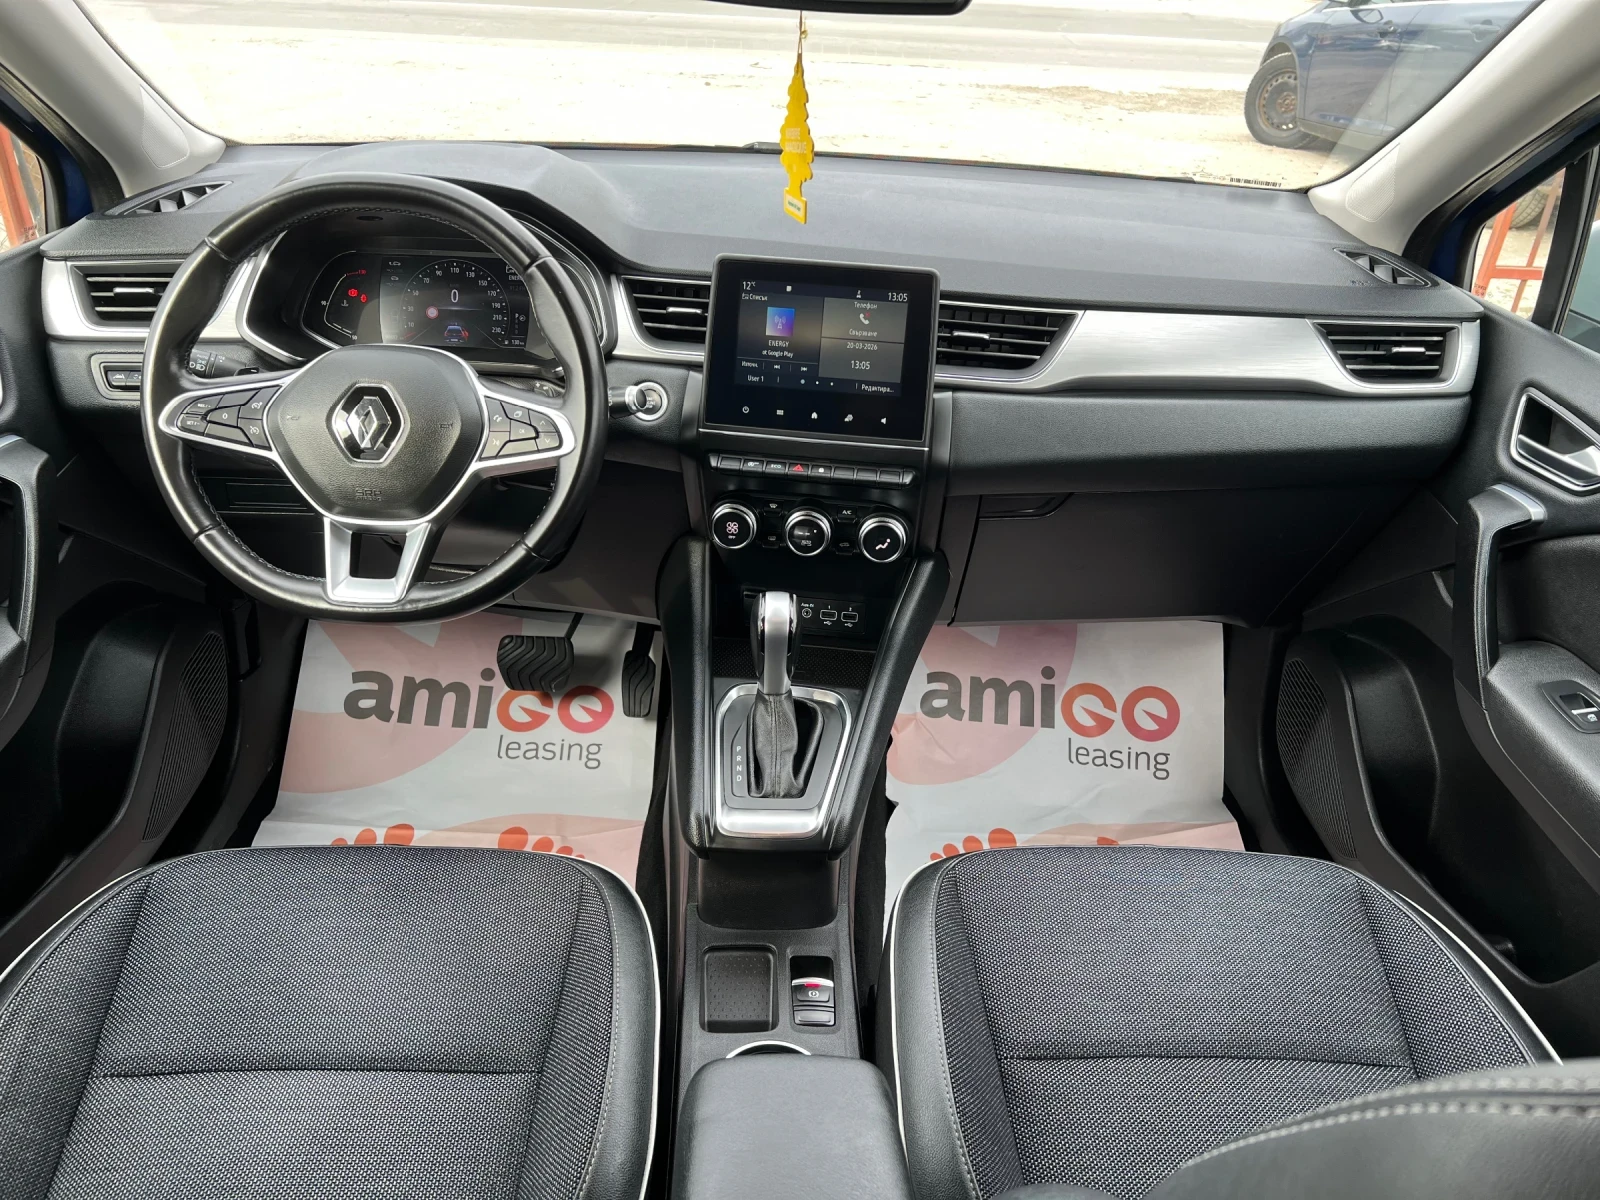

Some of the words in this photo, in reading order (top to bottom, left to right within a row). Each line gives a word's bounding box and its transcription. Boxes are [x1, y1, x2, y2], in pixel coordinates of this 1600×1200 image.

[451, 289, 459, 303] 0
[888, 292, 908, 302] 13:05
[854, 301, 878, 310] Телефон
[848, 328, 878, 338] Свързване
[768, 339, 790, 348] ENERGY
[847, 342, 878, 351] 20-03-2026
[768, 350, 783, 358] Google
[784, 351, 794, 359] Play
[850, 360, 871, 370] 13:05
[747, 374, 760, 382] User
[496, 734, 602, 770] leasing
[1067, 737, 1170, 780] leasing
